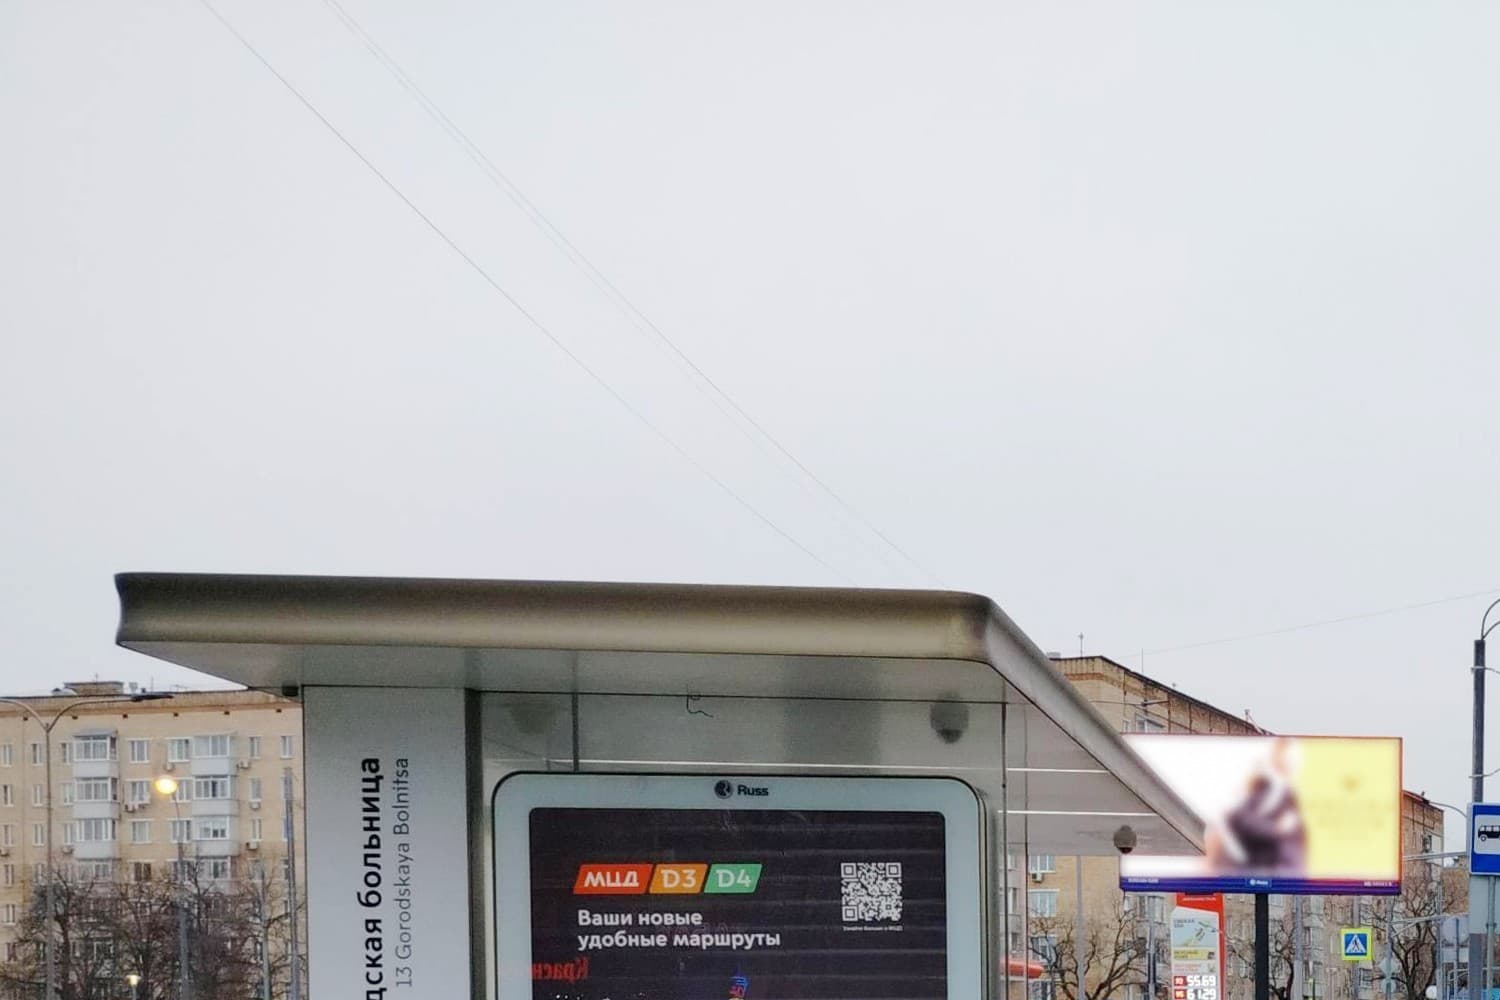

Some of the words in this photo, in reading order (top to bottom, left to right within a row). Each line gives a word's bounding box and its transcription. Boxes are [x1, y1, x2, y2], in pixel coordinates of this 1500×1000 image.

[392, 758, 410, 836] Bolnitsa
[737, 784, 769, 796] Russ
[356, 757, 385, 908] больница
[584, 871, 640, 887] МЦД
[661, 870, 697, 888] D3
[716, 870, 752, 888] D4
[393, 842, 414, 960] Gorodskaya
[577, 909, 633, 926] Ваши
[638, 912, 703, 926] новые
[577, 929, 668, 951] удобные
[673, 933, 781, 950] маршруты
[395, 966, 413, 987] 13
